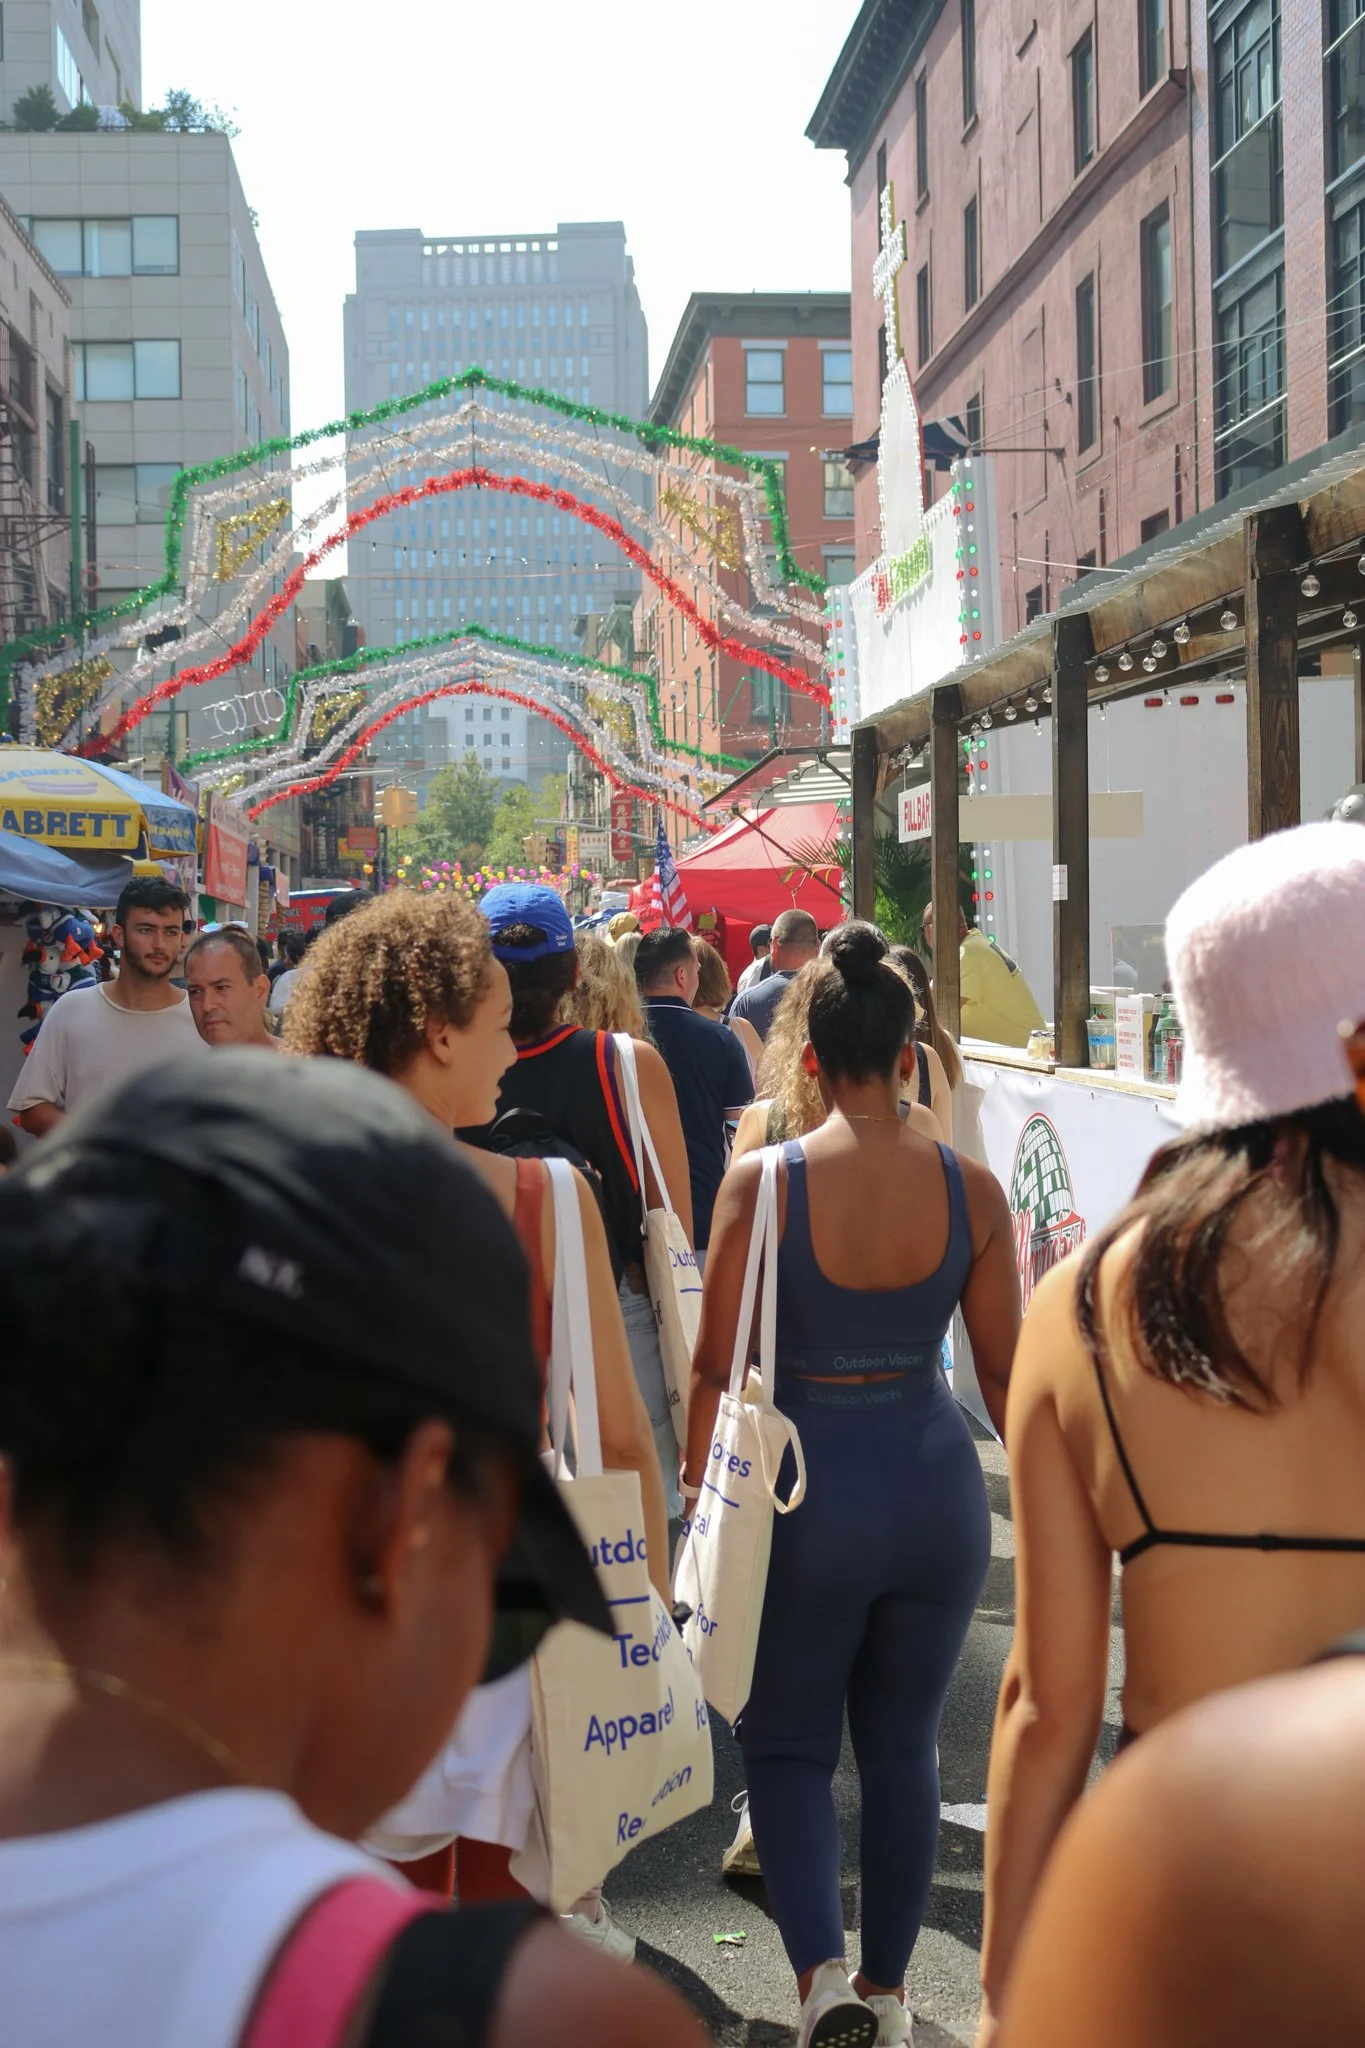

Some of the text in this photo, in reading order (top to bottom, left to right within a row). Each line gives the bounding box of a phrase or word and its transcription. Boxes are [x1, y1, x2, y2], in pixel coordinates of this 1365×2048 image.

[833, 1352, 923, 1370] Outdoor Voices
[806, 1388, 903, 1405] Outdoor Voices
[696, 1602, 718, 1637] for
[584, 1686, 674, 1757] Apparel
